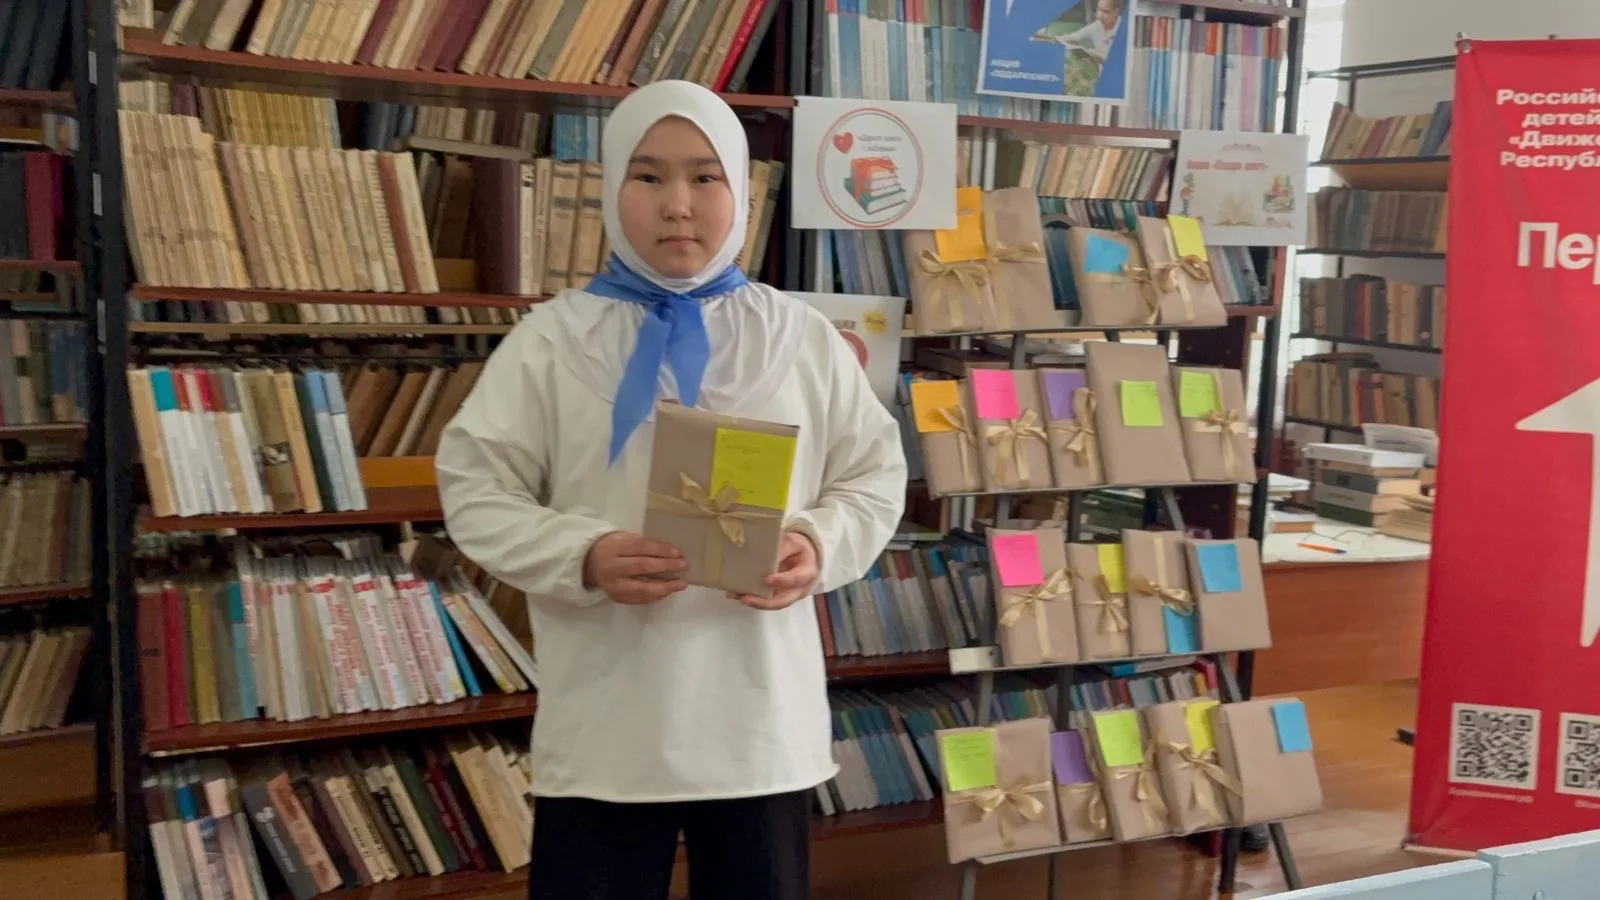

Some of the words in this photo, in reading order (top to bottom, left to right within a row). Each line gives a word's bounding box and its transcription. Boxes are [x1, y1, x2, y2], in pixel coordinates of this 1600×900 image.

[1496, 88, 1600, 105] Россий
[1500, 150, 1600, 171] Респуб
[1517, 221, 1600, 285] Пе
